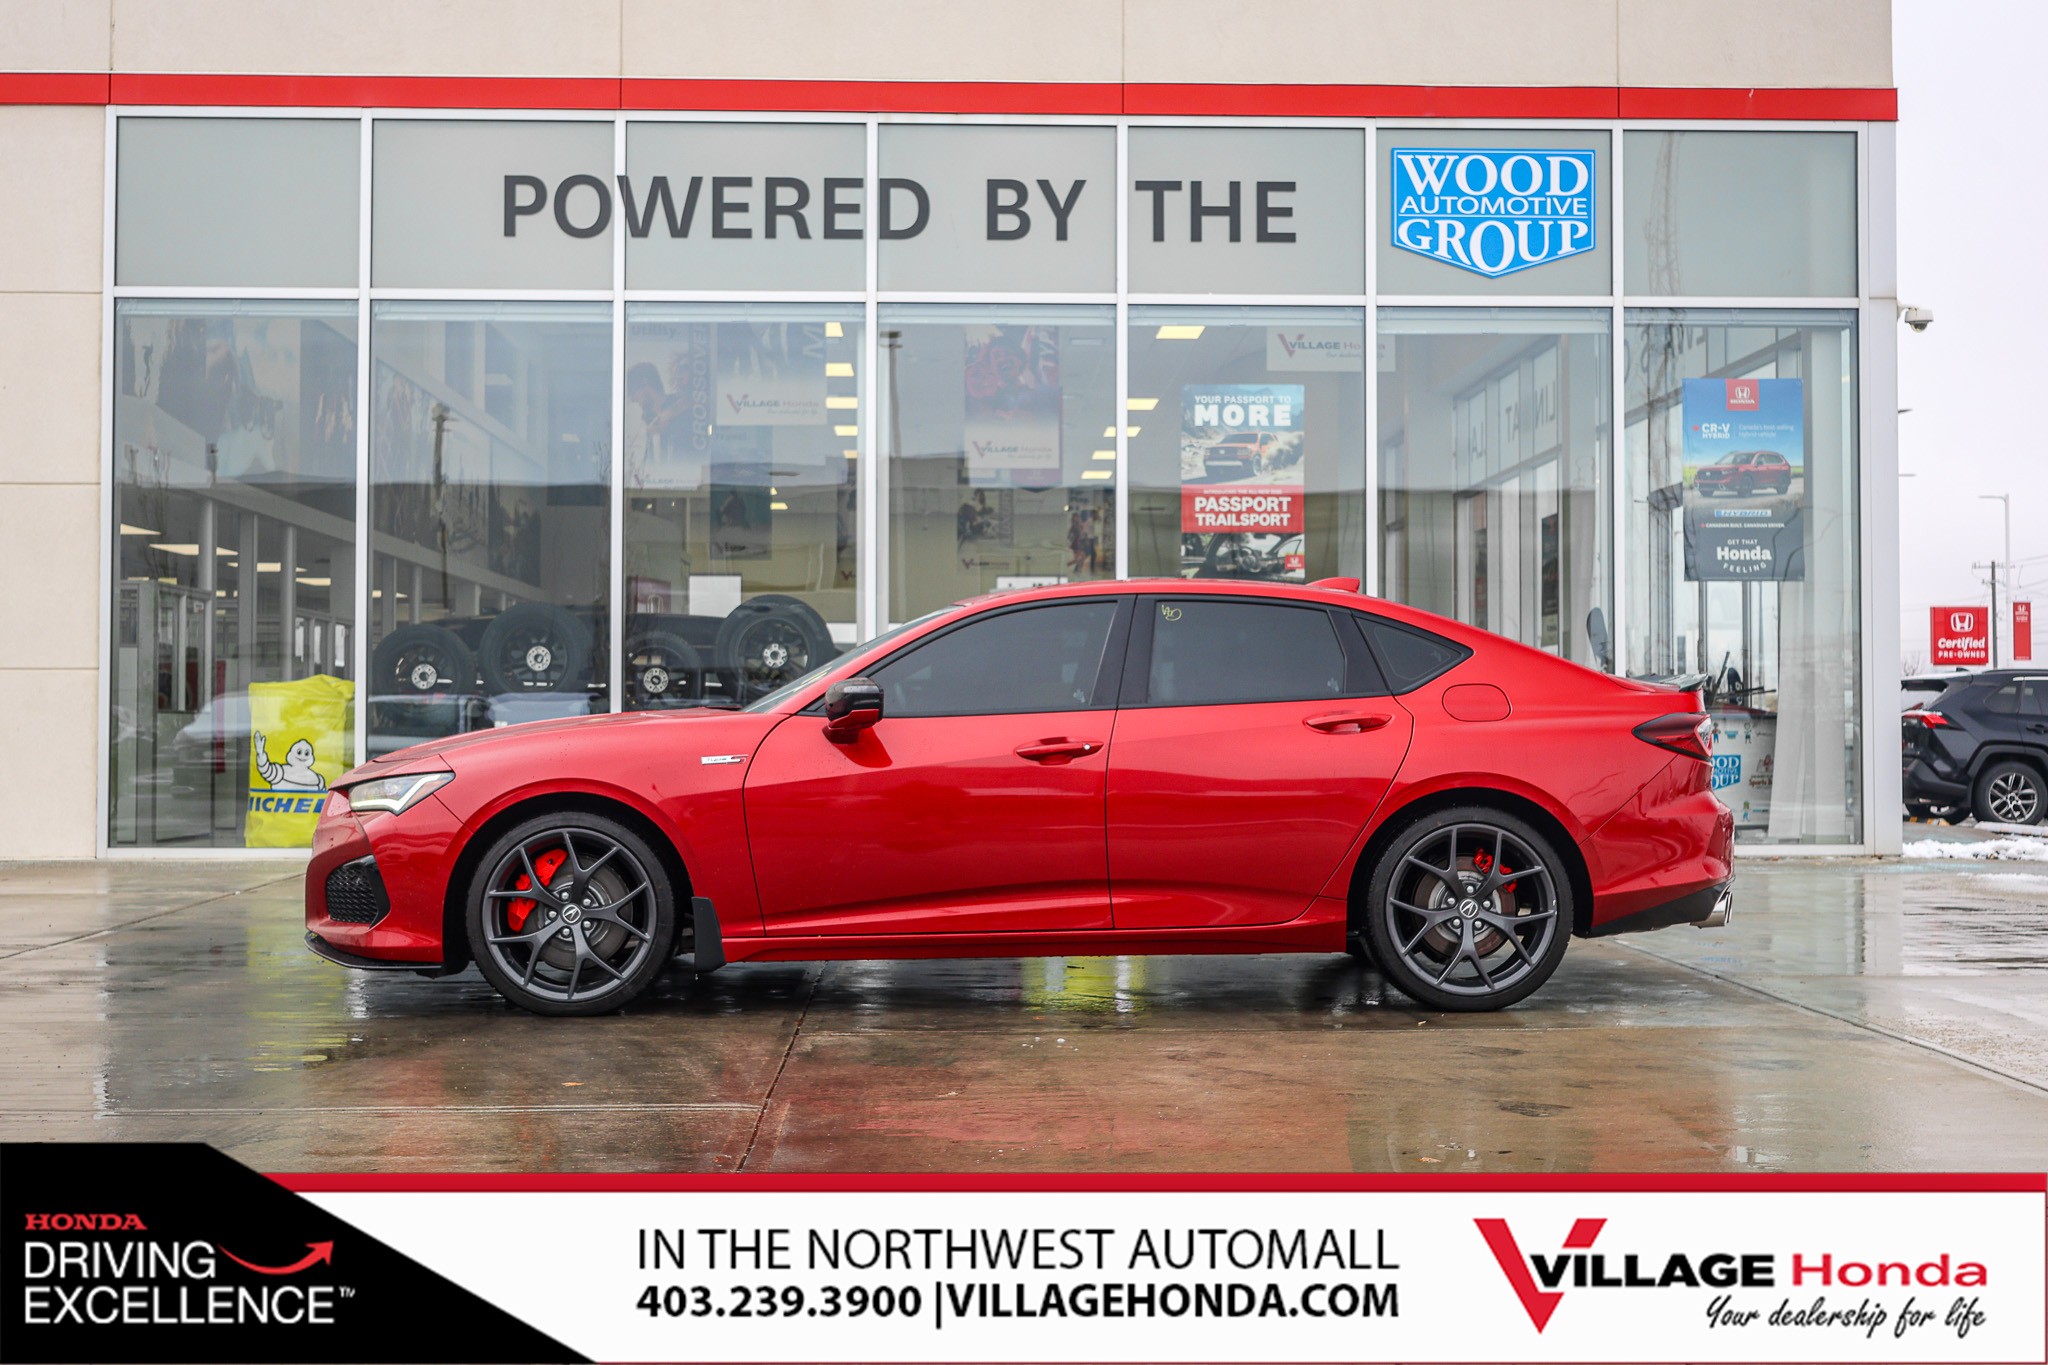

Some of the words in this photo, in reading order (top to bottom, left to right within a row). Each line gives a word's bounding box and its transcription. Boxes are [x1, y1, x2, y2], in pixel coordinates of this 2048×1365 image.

[1397, 154, 1589, 196] WOOD
[504, 174, 931, 240] POWERED
[987, 179, 1087, 241] BY
[1135, 180, 1297, 243] THE
[1400, 196, 1588, 215] AUTOMOTIVE
[1397, 218, 1589, 272] GROUP
[1290, 341, 1340, 350] VILLAGE
[736, 400, 780, 408] VILLAGE
[1194, 395, 1222, 404] YOUR
[1223, 395, 1275, 404] PASSPORT
[1278, 395, 1292, 404] TO
[1194, 403, 1292, 427] MORE
[1702, 422, 1731, 433] CR-V
[1194, 496, 1292, 512] PASSPORT
[1195, 513, 1291, 526] TRAILSPORT
[1727, 538, 1740, 546] GET
[1741, 538, 1758, 546] THAT
[1717, 545, 1772, 561] Honda
[1723, 561, 1767, 574] FEELING
[1938, 636, 1986, 650] Certified
